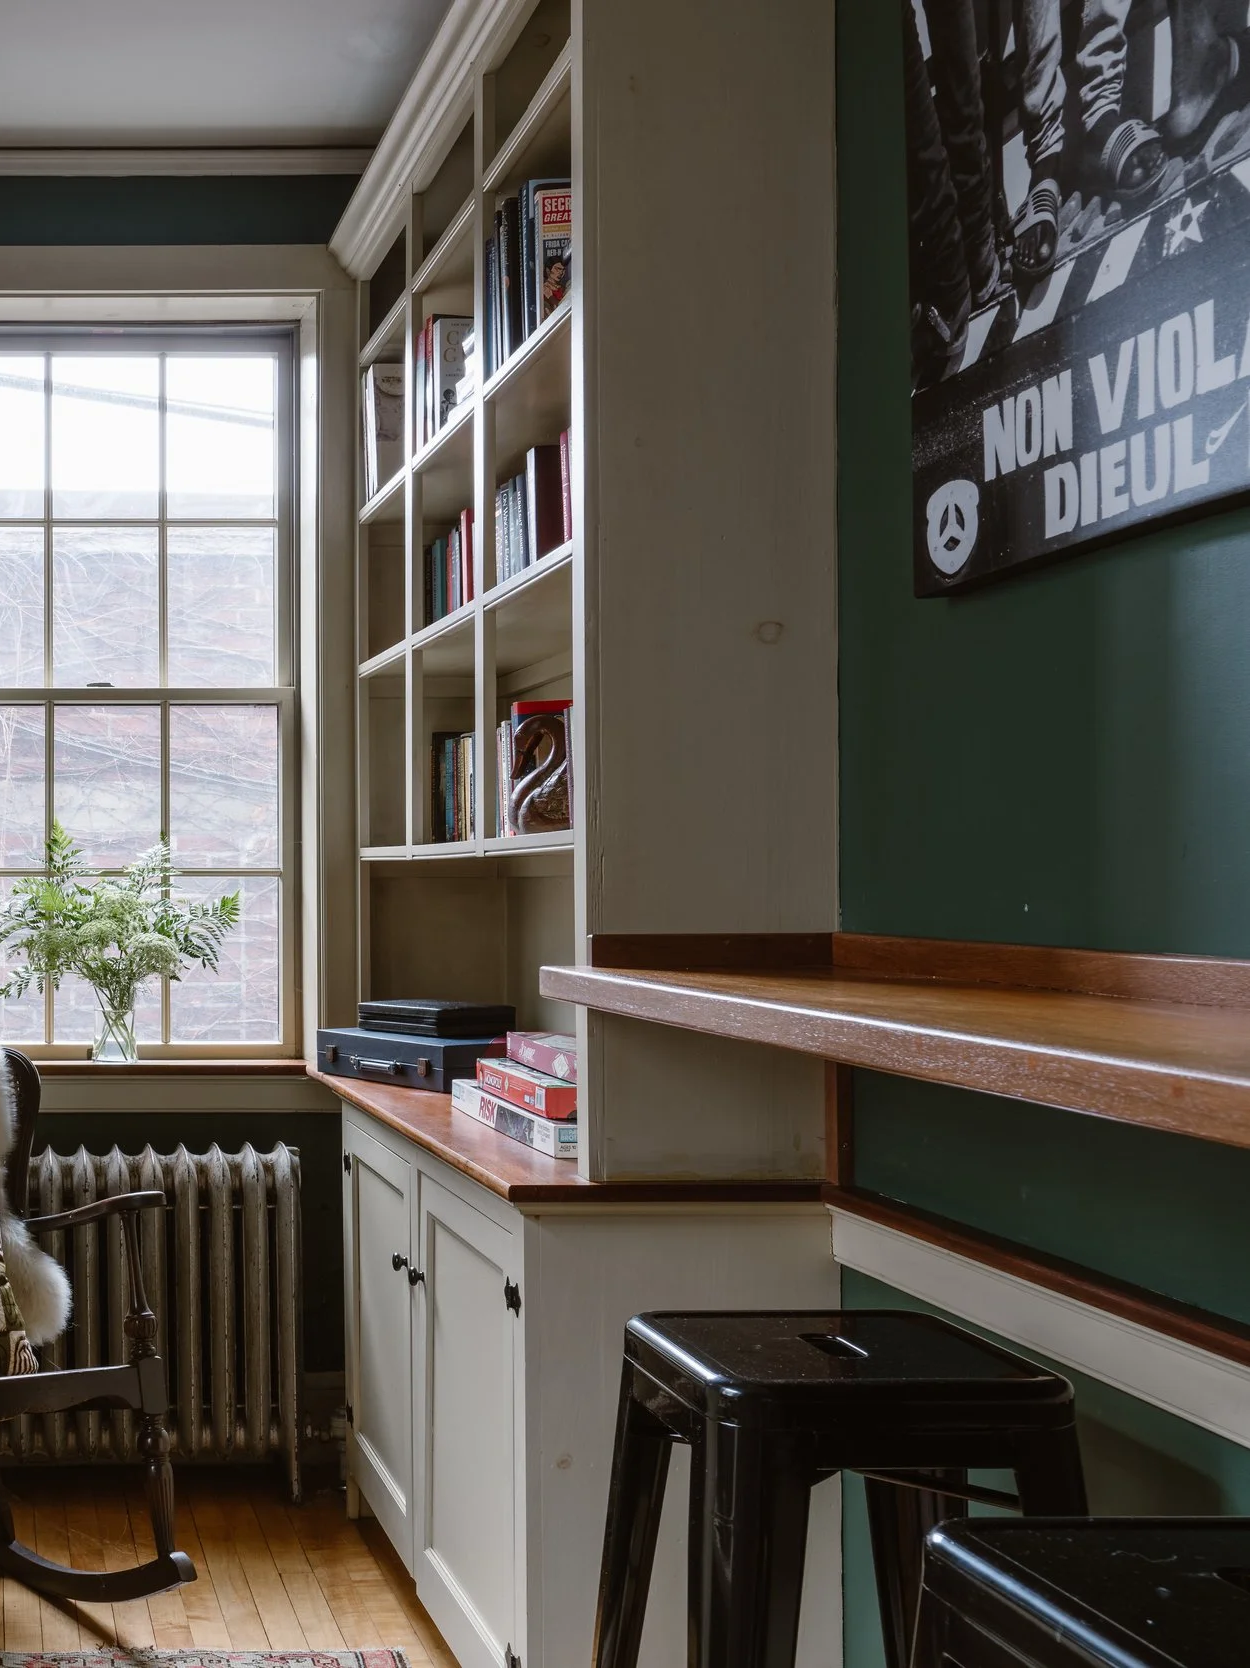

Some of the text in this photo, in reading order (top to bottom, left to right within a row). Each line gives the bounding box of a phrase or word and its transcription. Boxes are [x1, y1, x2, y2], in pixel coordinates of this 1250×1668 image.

[983, 369, 1074, 481] NON
[1044, 413, 1211, 539] DIEUL
[478, 1096, 497, 1124] RISK
